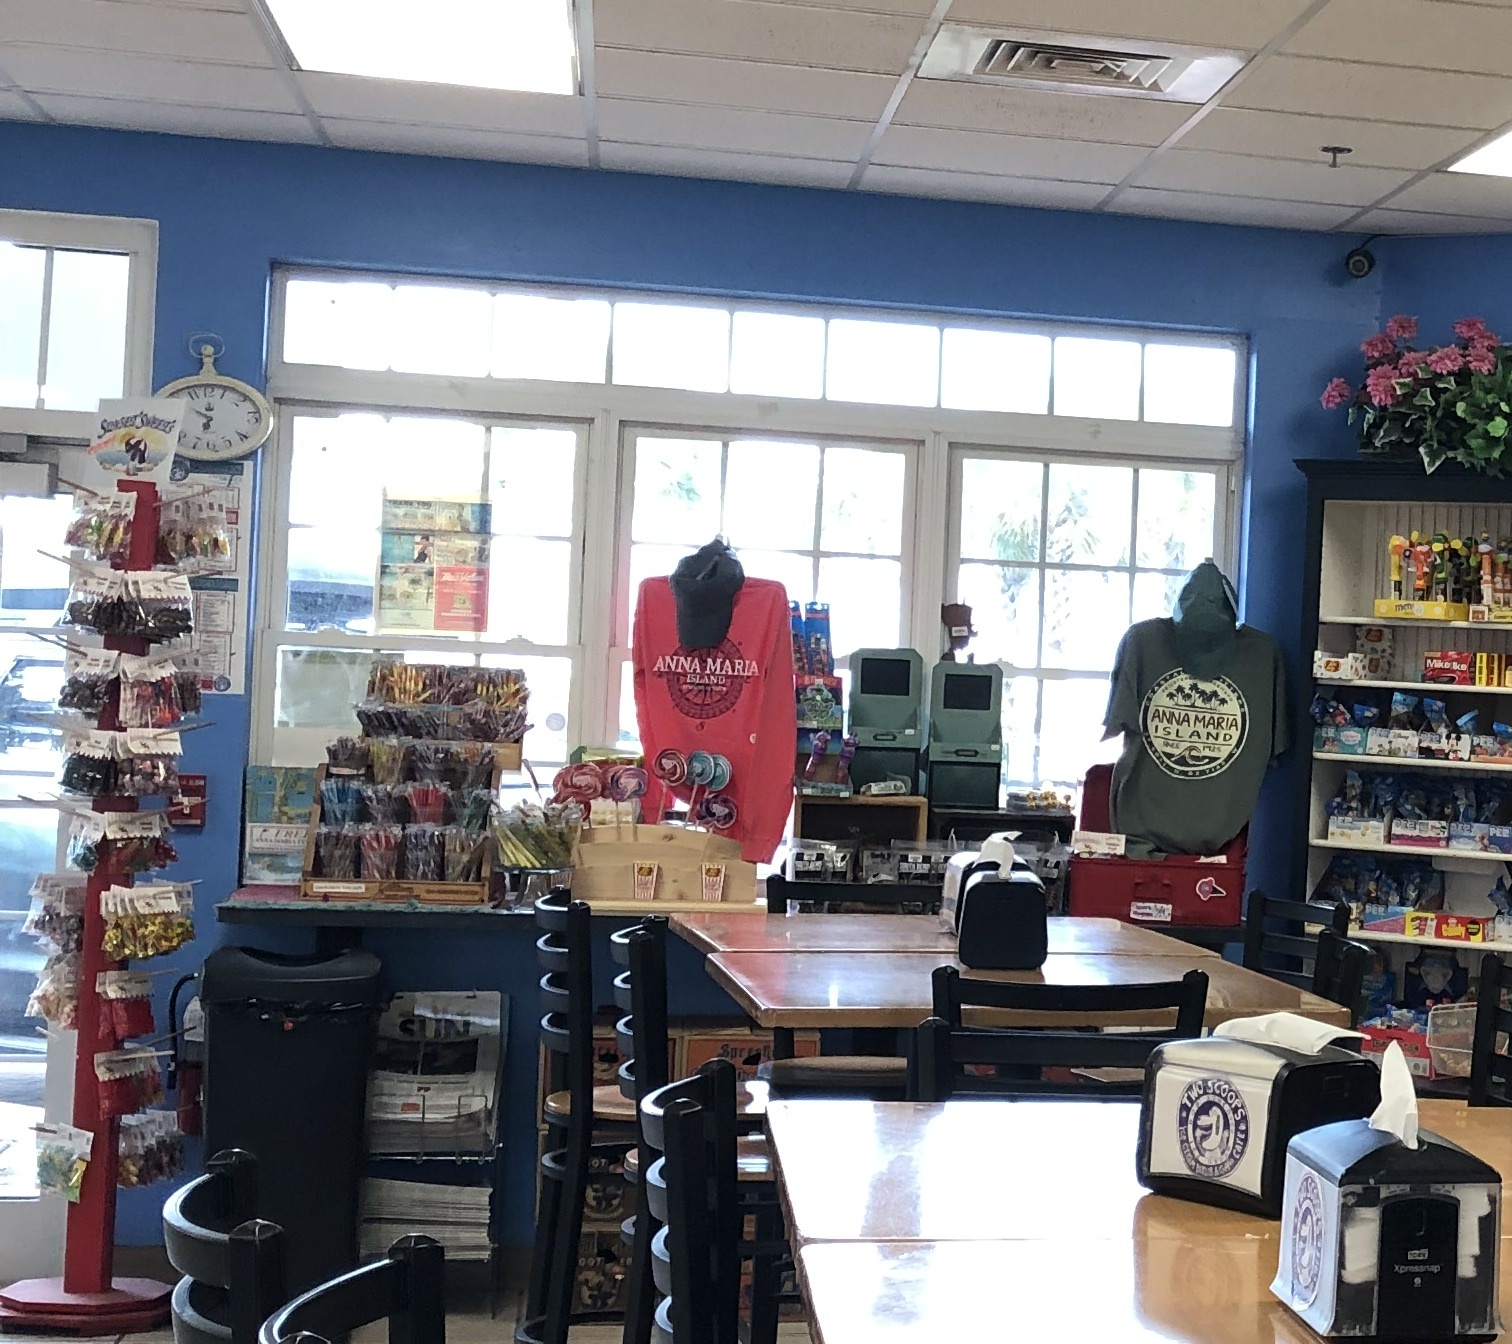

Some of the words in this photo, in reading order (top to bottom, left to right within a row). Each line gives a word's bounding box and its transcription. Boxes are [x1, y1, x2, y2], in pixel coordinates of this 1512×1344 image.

[653, 655, 701, 674] ANNA
[705, 658, 760, 676] MARIA
[1426, 658, 1451, 670] Mike
[686, 674, 726, 685] ISLAND
[1151, 708, 1191, 728] ANNA
[1193, 714, 1239, 732] MARIA
[1154, 724, 1233, 743] ISLAND
[1489, 826, 1510, 837] PEZ
[1182, 1080, 1204, 1108] TWO
[1206, 1079, 1246, 1121] SCOOPS
[1232, 1131, 1246, 1159] CAFE
[1393, 1264, 1441, 1274] Xpressnap
